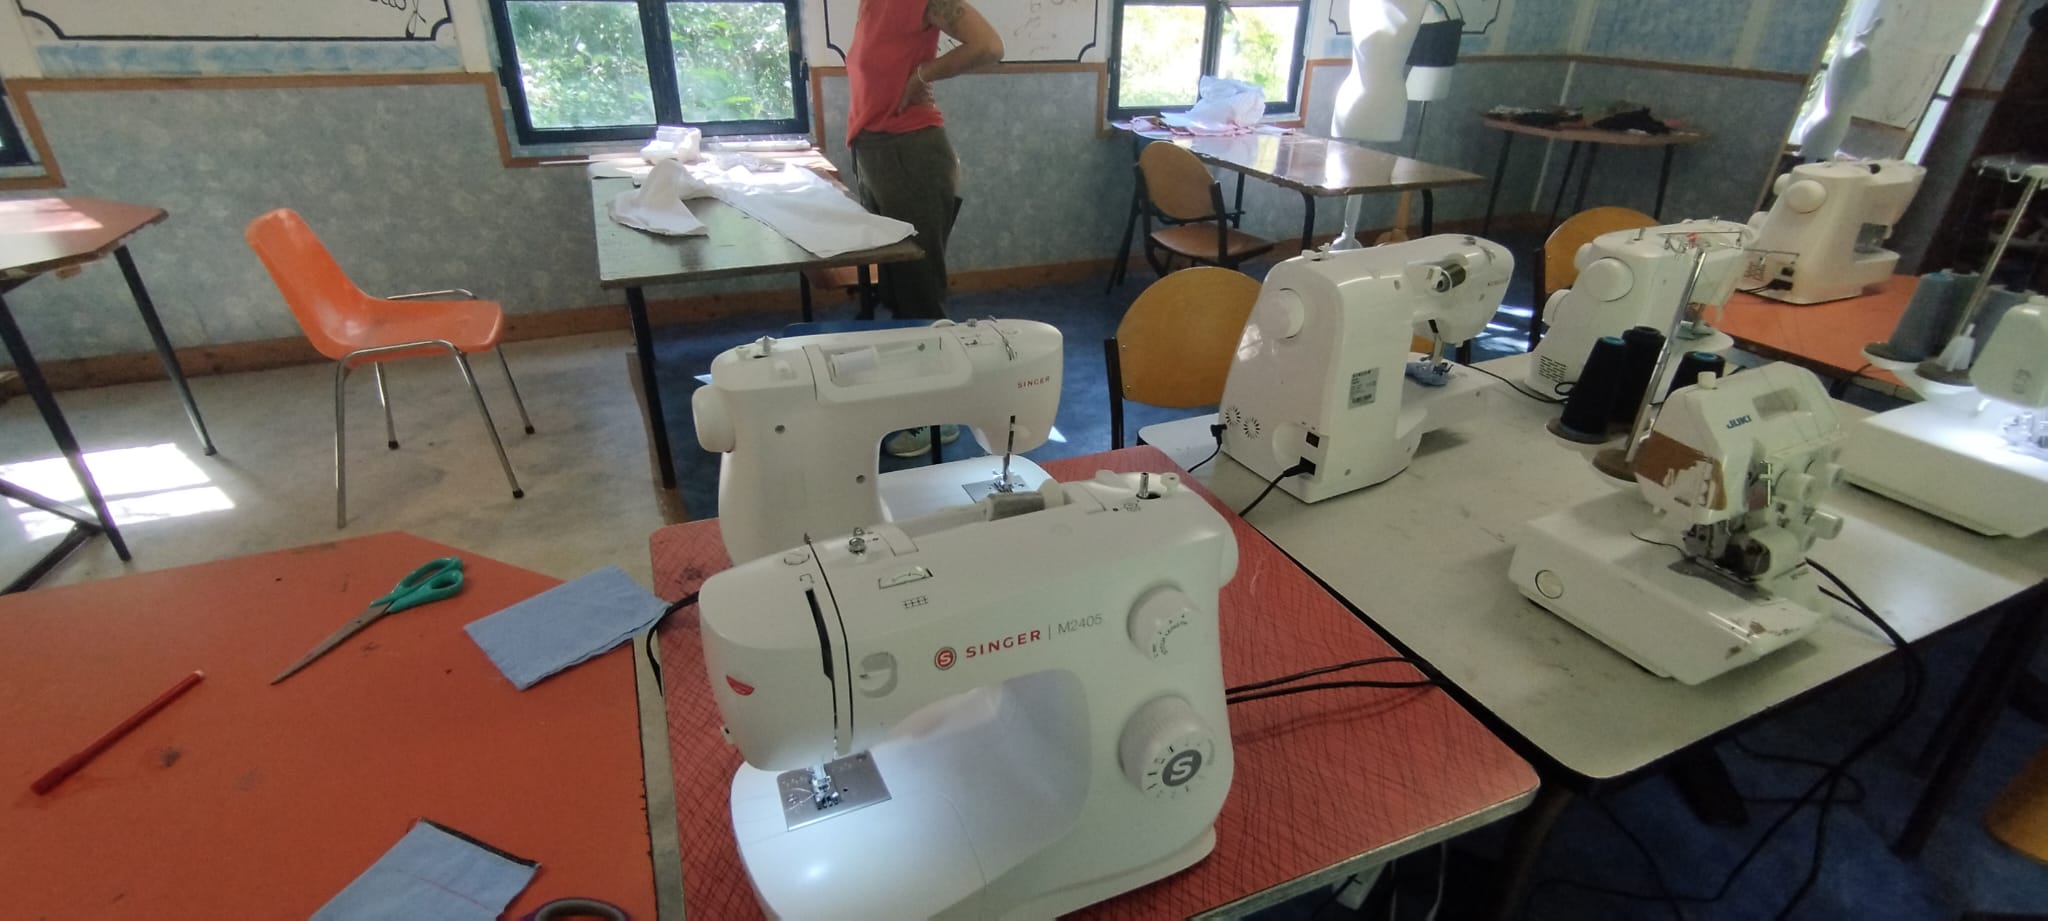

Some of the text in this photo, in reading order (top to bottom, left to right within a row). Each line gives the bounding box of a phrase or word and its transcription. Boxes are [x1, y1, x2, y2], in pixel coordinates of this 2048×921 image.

[1726, 415, 1752, 429] JUKI
[965, 630, 1042, 658] SINGER
[1058, 613, 1103, 634] M2405
